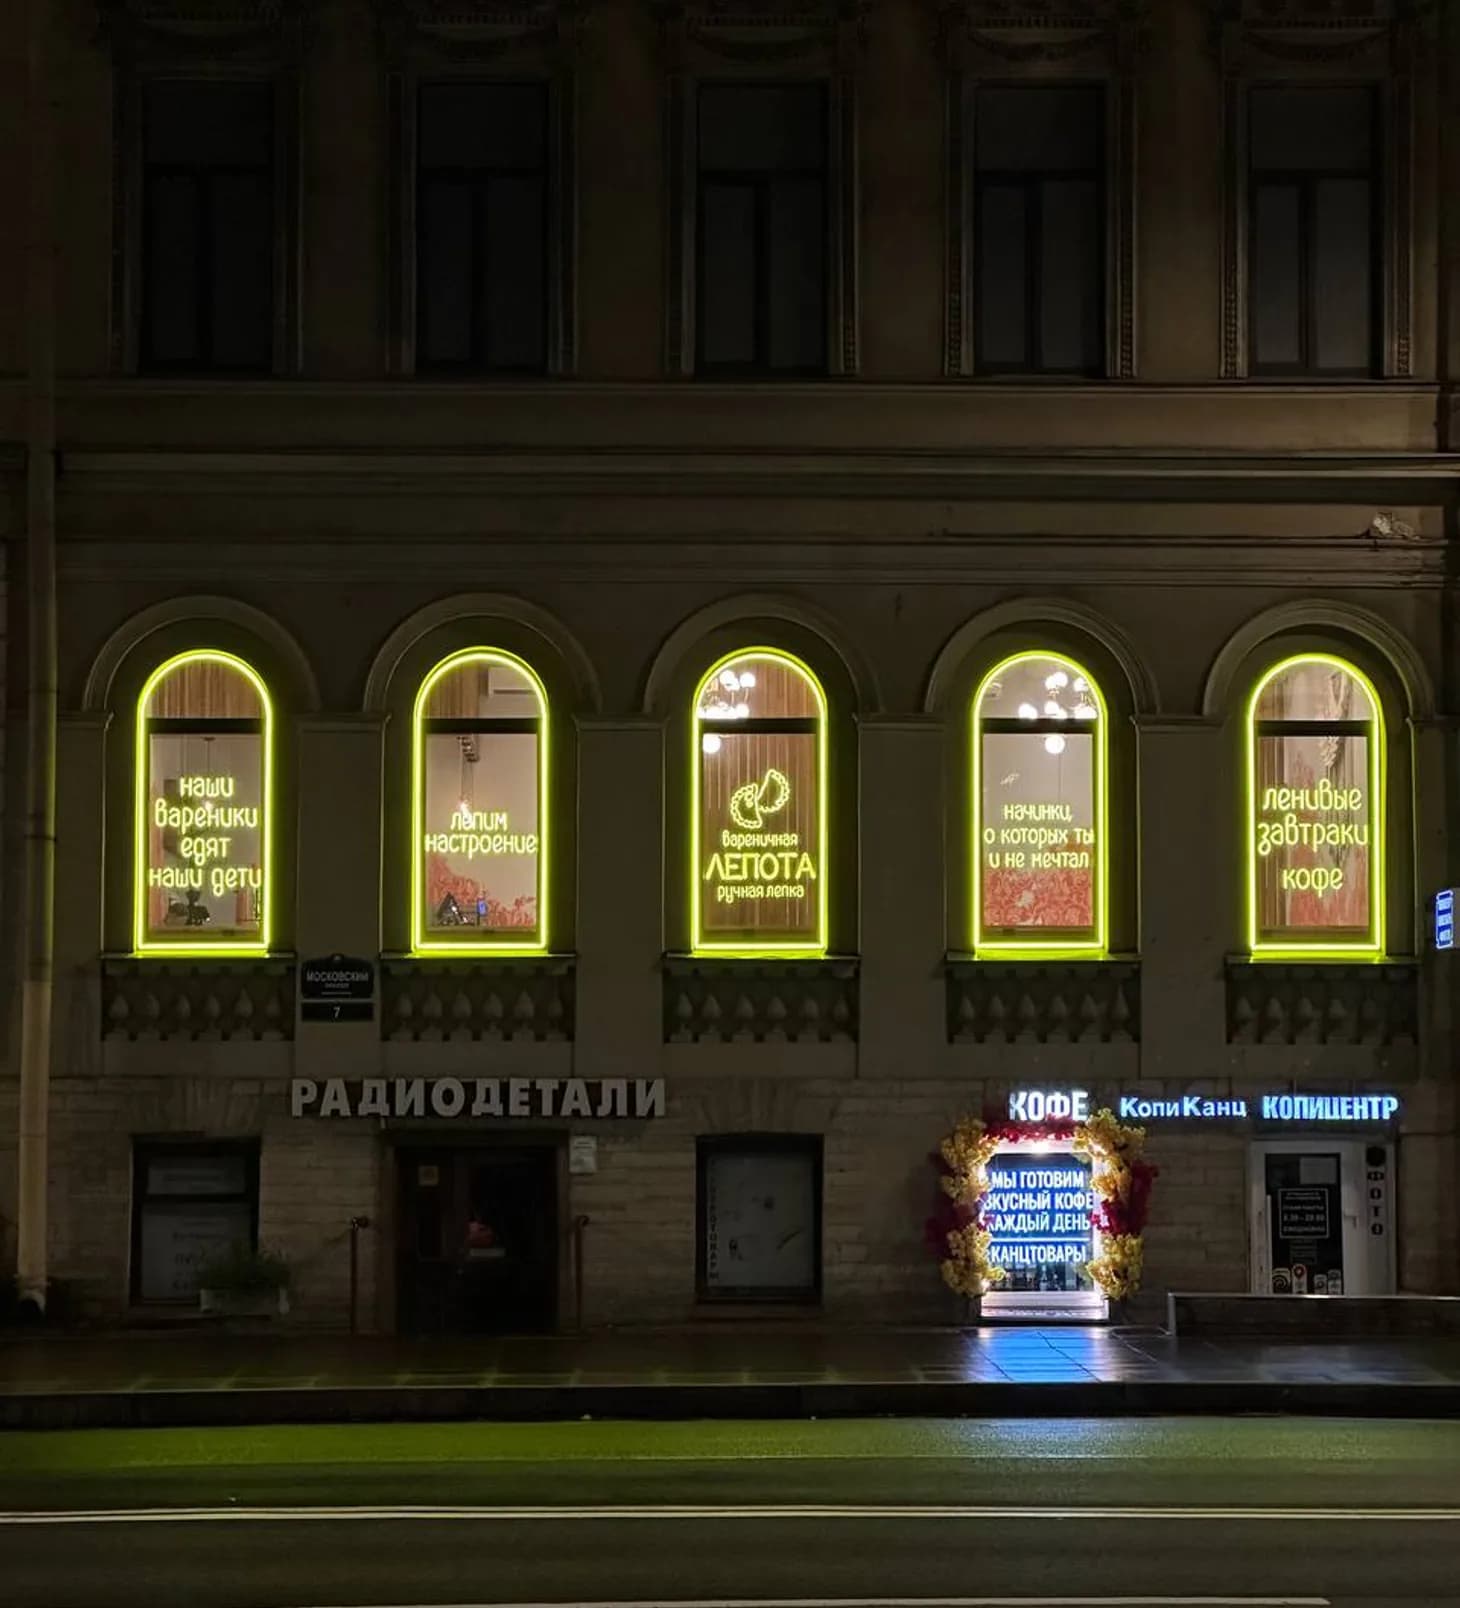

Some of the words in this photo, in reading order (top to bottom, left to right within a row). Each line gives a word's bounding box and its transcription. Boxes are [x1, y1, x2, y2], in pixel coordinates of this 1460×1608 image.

[180, 777, 233, 797] наши
[1263, 778, 1362, 810] ленивые
[155, 798, 257, 834] вареники
[450, 811, 508, 831] лепим
[1004, 804, 1073, 822] начинки,
[722, 829, 798, 850] вареничная
[984, 828, 995, 844] о
[1001, 828, 1068, 849] которых
[1074, 828, 1095, 844] ты
[1257, 813, 1368, 856] завтраки
[181, 837, 232, 866] едят
[424, 833, 538, 860] настроение
[705, 852, 816, 880] ЛЕПОТА
[989, 852, 1000, 868] и
[1005, 852, 1024, 868] не
[1032, 852, 1089, 868] мечтал
[149, 867, 202, 888] наши
[211, 867, 262, 896] дети
[1283, 867, 1343, 898] кофе
[718, 885, 764, 904] ручная
[766, 885, 804, 898] лепка
[333, 1005, 340, 1018] 7
[291, 1077, 665, 1118] РАДИОДЕТАЛИ
[1010, 1091, 1088, 1121] КОФЕ
[1263, 1095, 1398, 1120] КОПИЦЕНТР
[992, 1171, 1017, 1188] МЫ
[1020, 1171, 1084, 1188] ГОТОВИМ
[1055, 1192, 1093, 1210] КОФЕ
[1052, 1213, 1090, 1232] ДЕНЬ
[991, 1245, 1086, 1264] КАНЦТОВАРЫ
